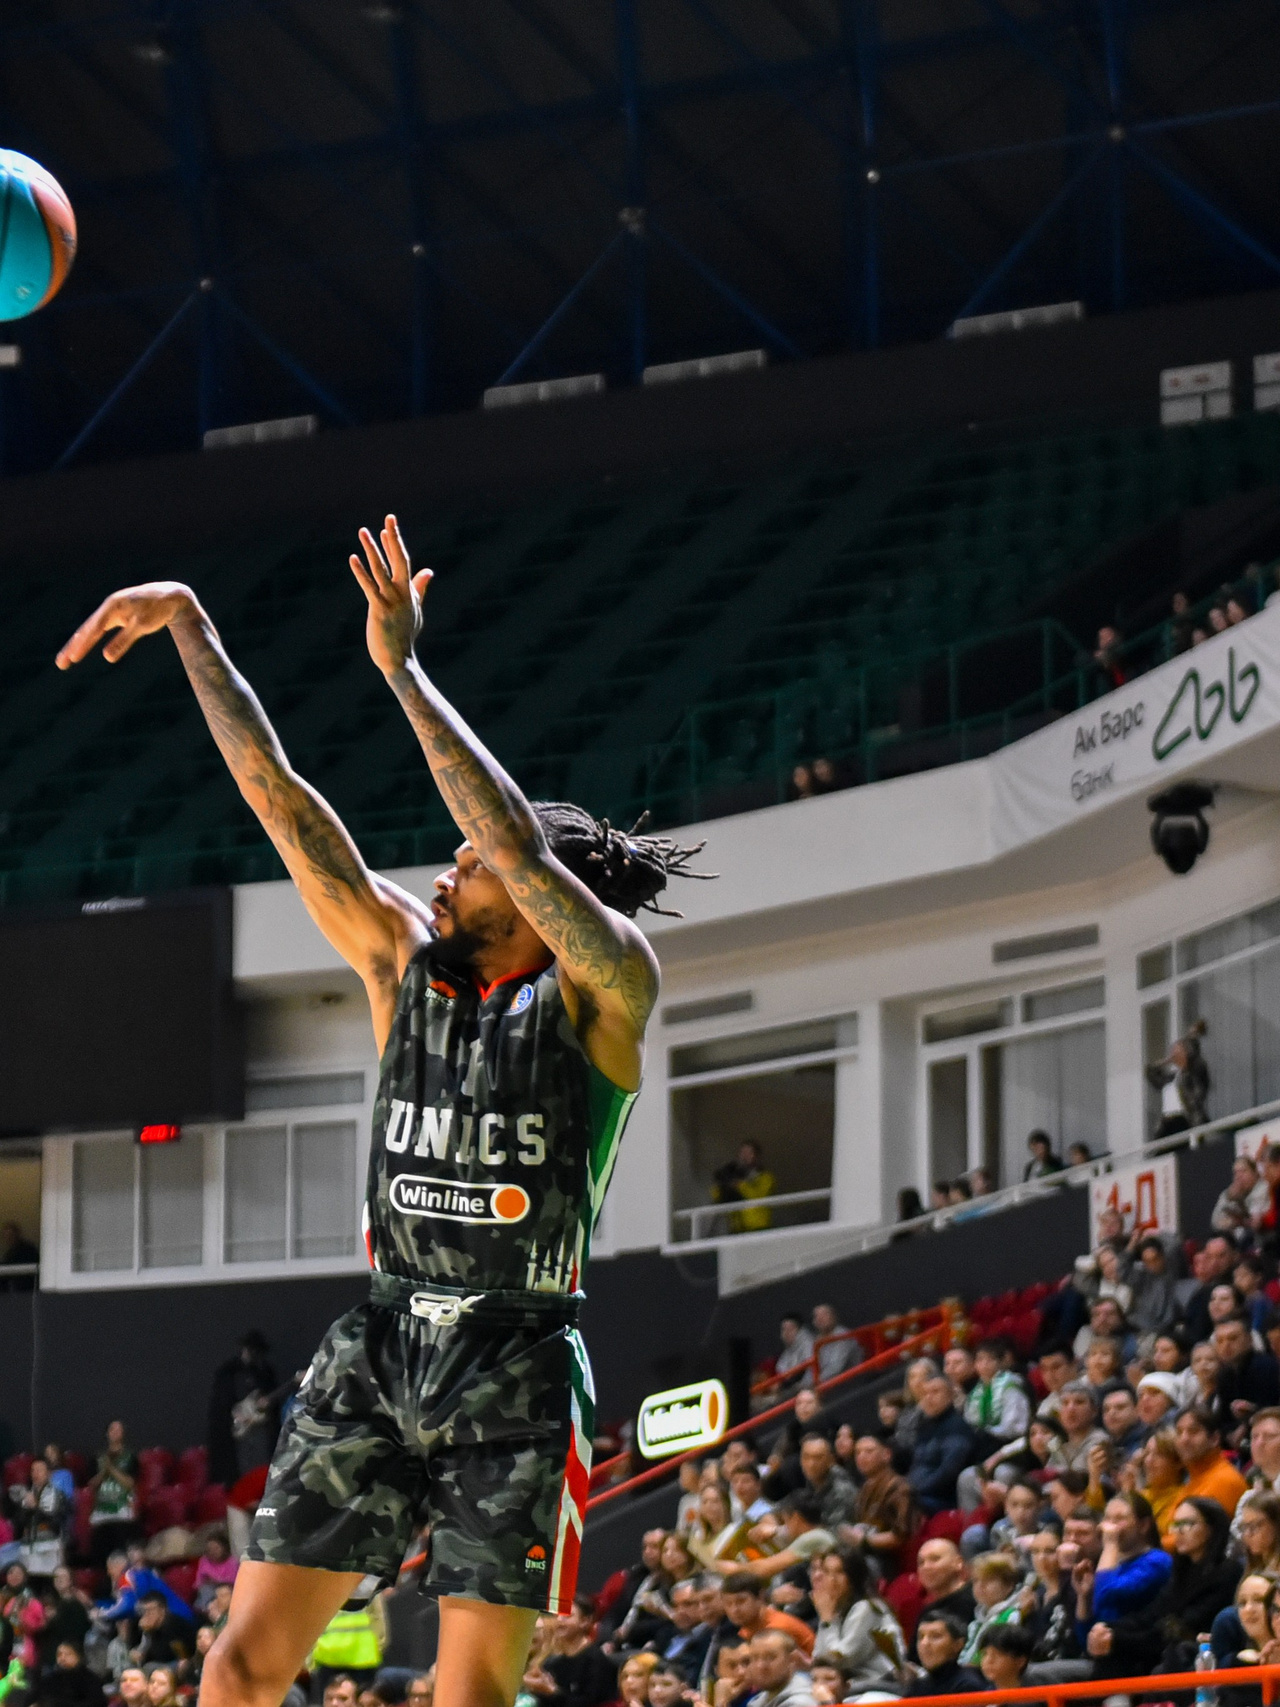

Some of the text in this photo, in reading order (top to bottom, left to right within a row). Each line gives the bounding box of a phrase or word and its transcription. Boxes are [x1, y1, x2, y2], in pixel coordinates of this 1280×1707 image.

[1072, 700, 1145, 759] Ак Барс
[385, 1098, 546, 1166] UNICS
[399, 1183, 485, 1214] Winline
